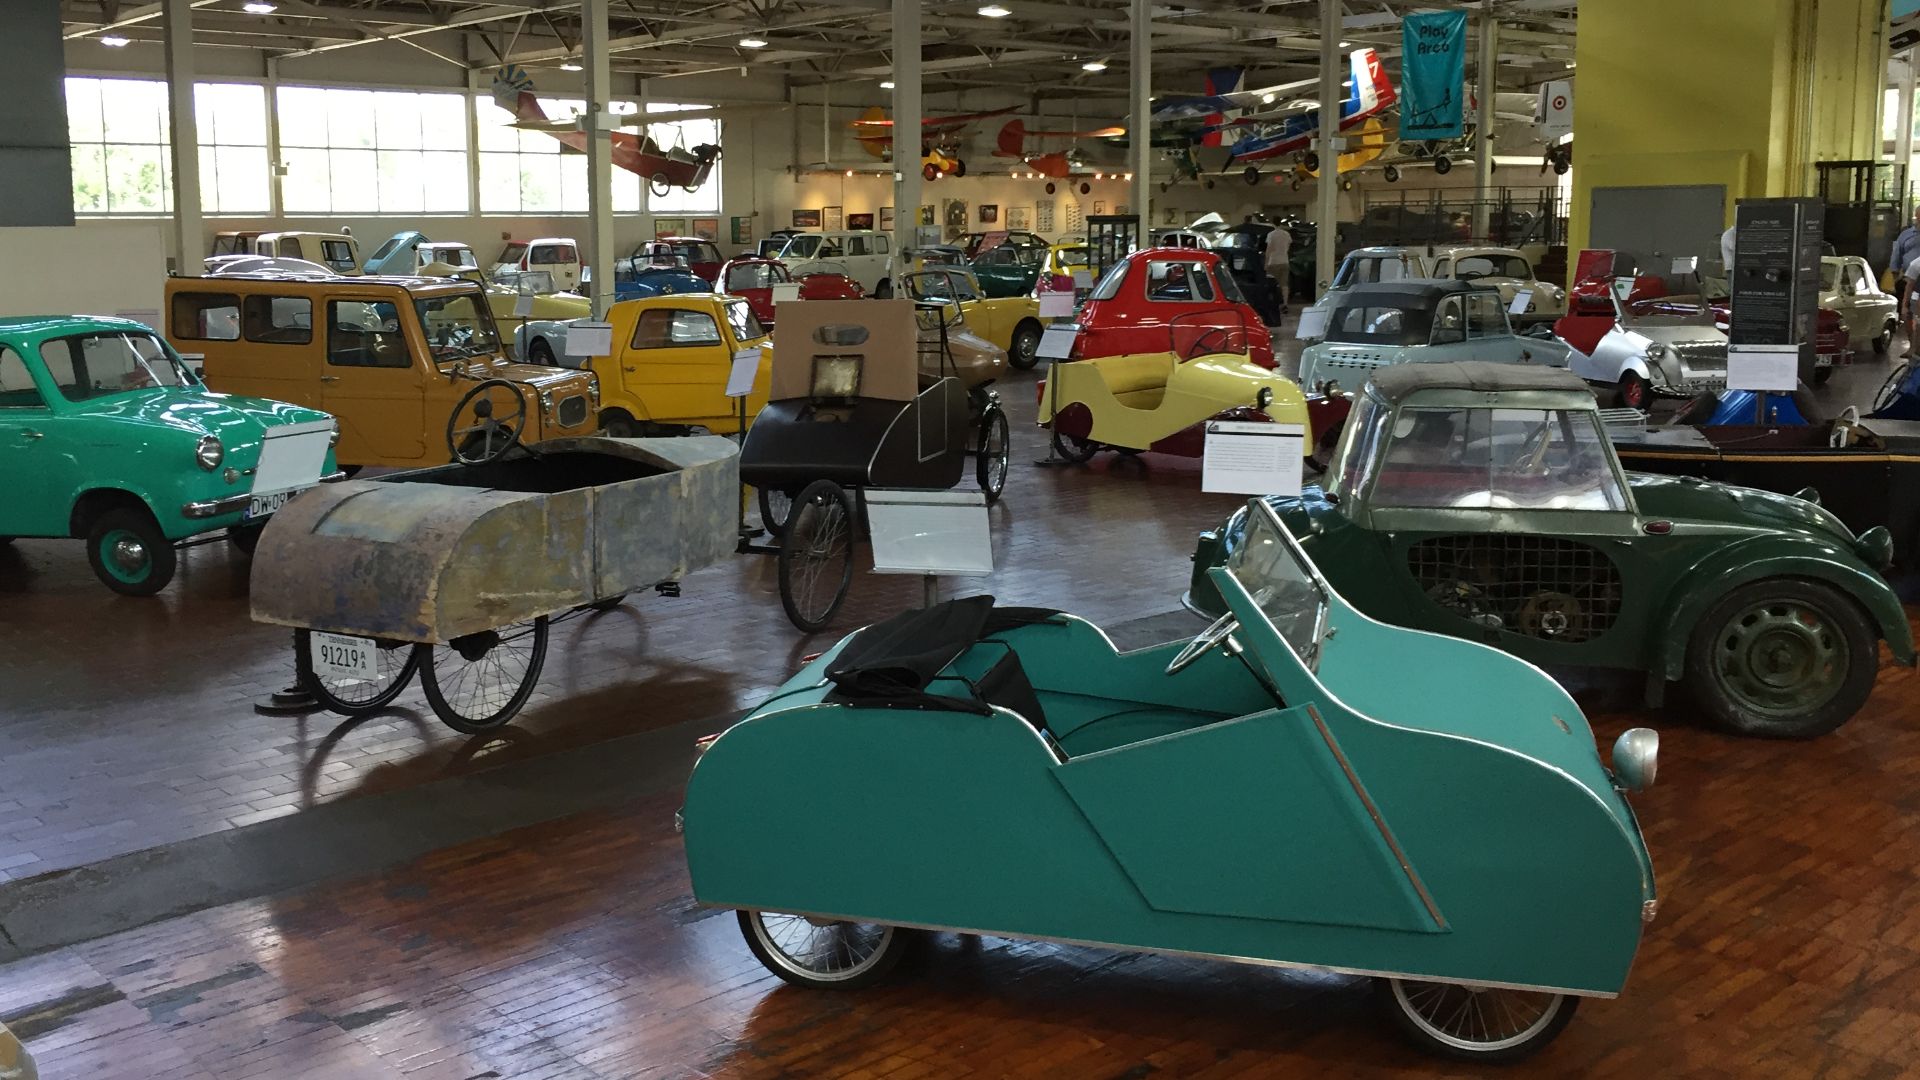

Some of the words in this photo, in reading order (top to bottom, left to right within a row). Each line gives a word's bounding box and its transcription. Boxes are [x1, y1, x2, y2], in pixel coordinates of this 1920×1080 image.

[1419, 24, 1449, 39] Play
[1417, 41, 1450, 55] Area
[1368, 61, 1379, 78] 7
[321, 644, 358, 668] 91219
